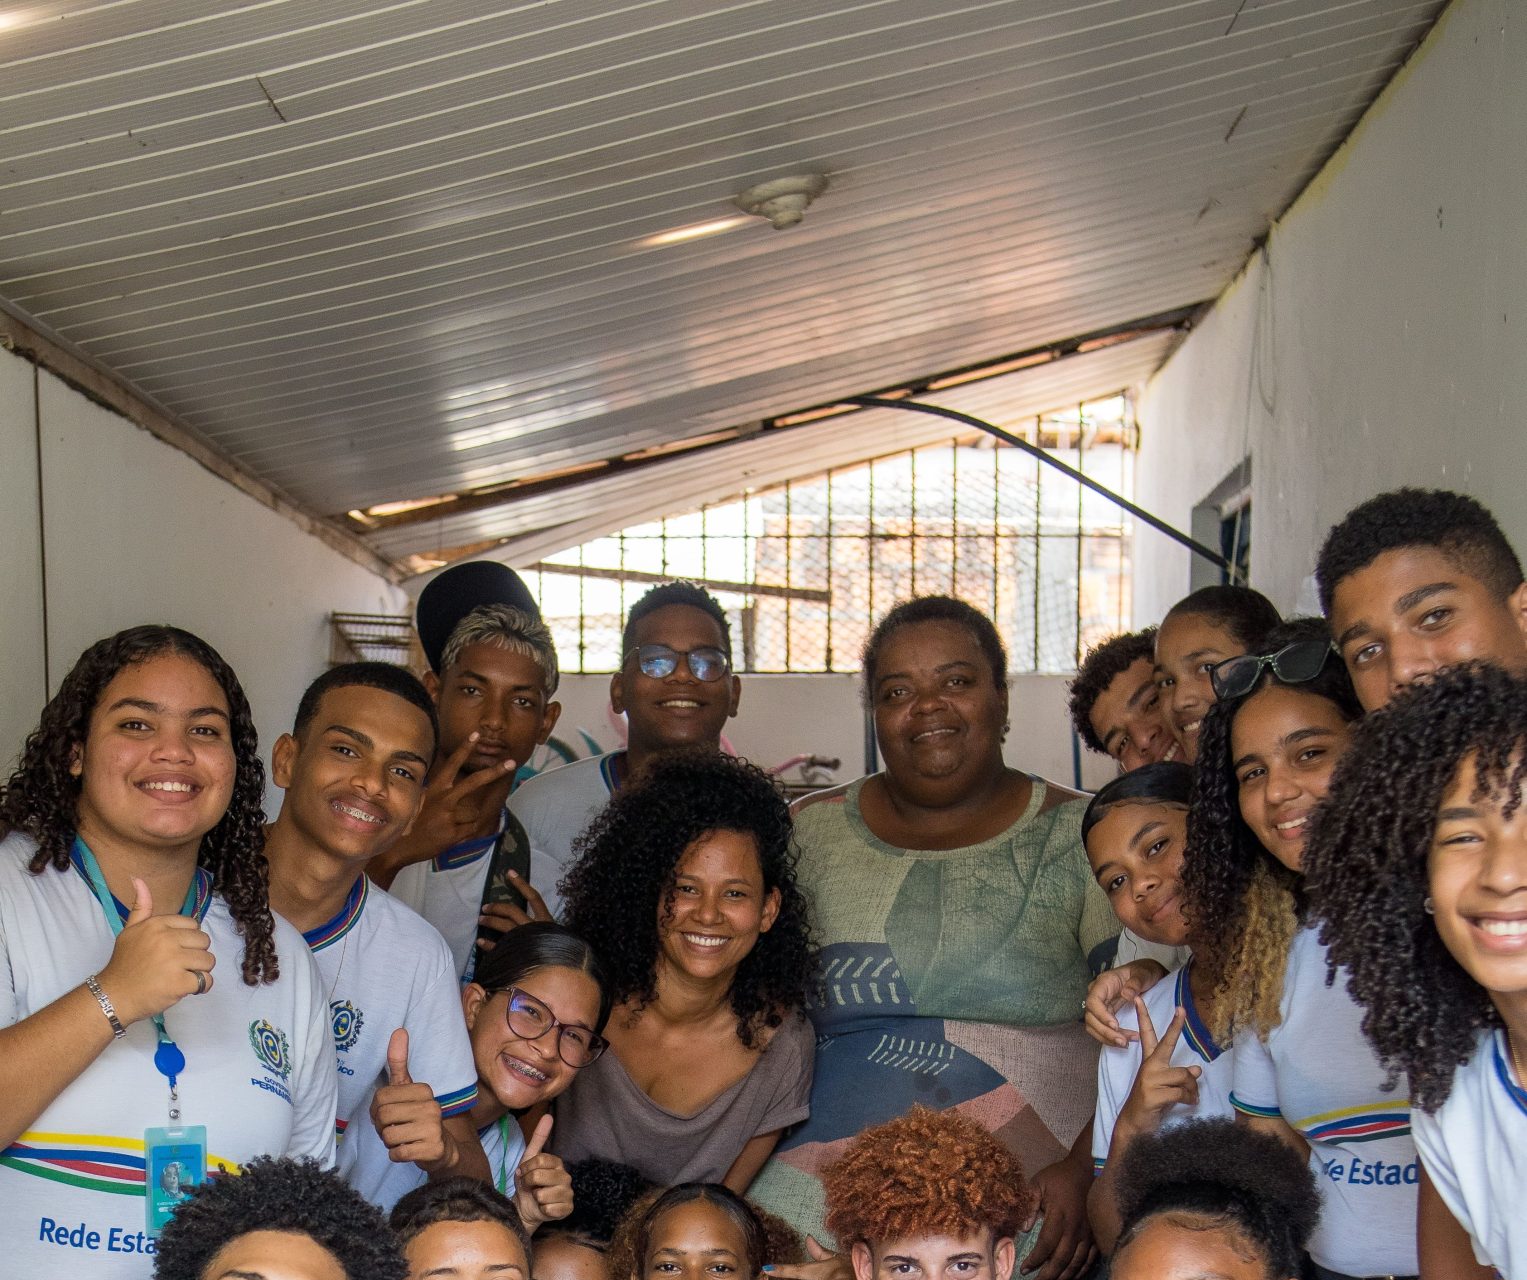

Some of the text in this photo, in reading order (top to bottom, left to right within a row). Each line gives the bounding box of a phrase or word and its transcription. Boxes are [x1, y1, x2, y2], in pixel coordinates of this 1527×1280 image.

[1347, 1157, 1420, 1186] Estad
[39, 1217, 158, 1255] Rede Esta
